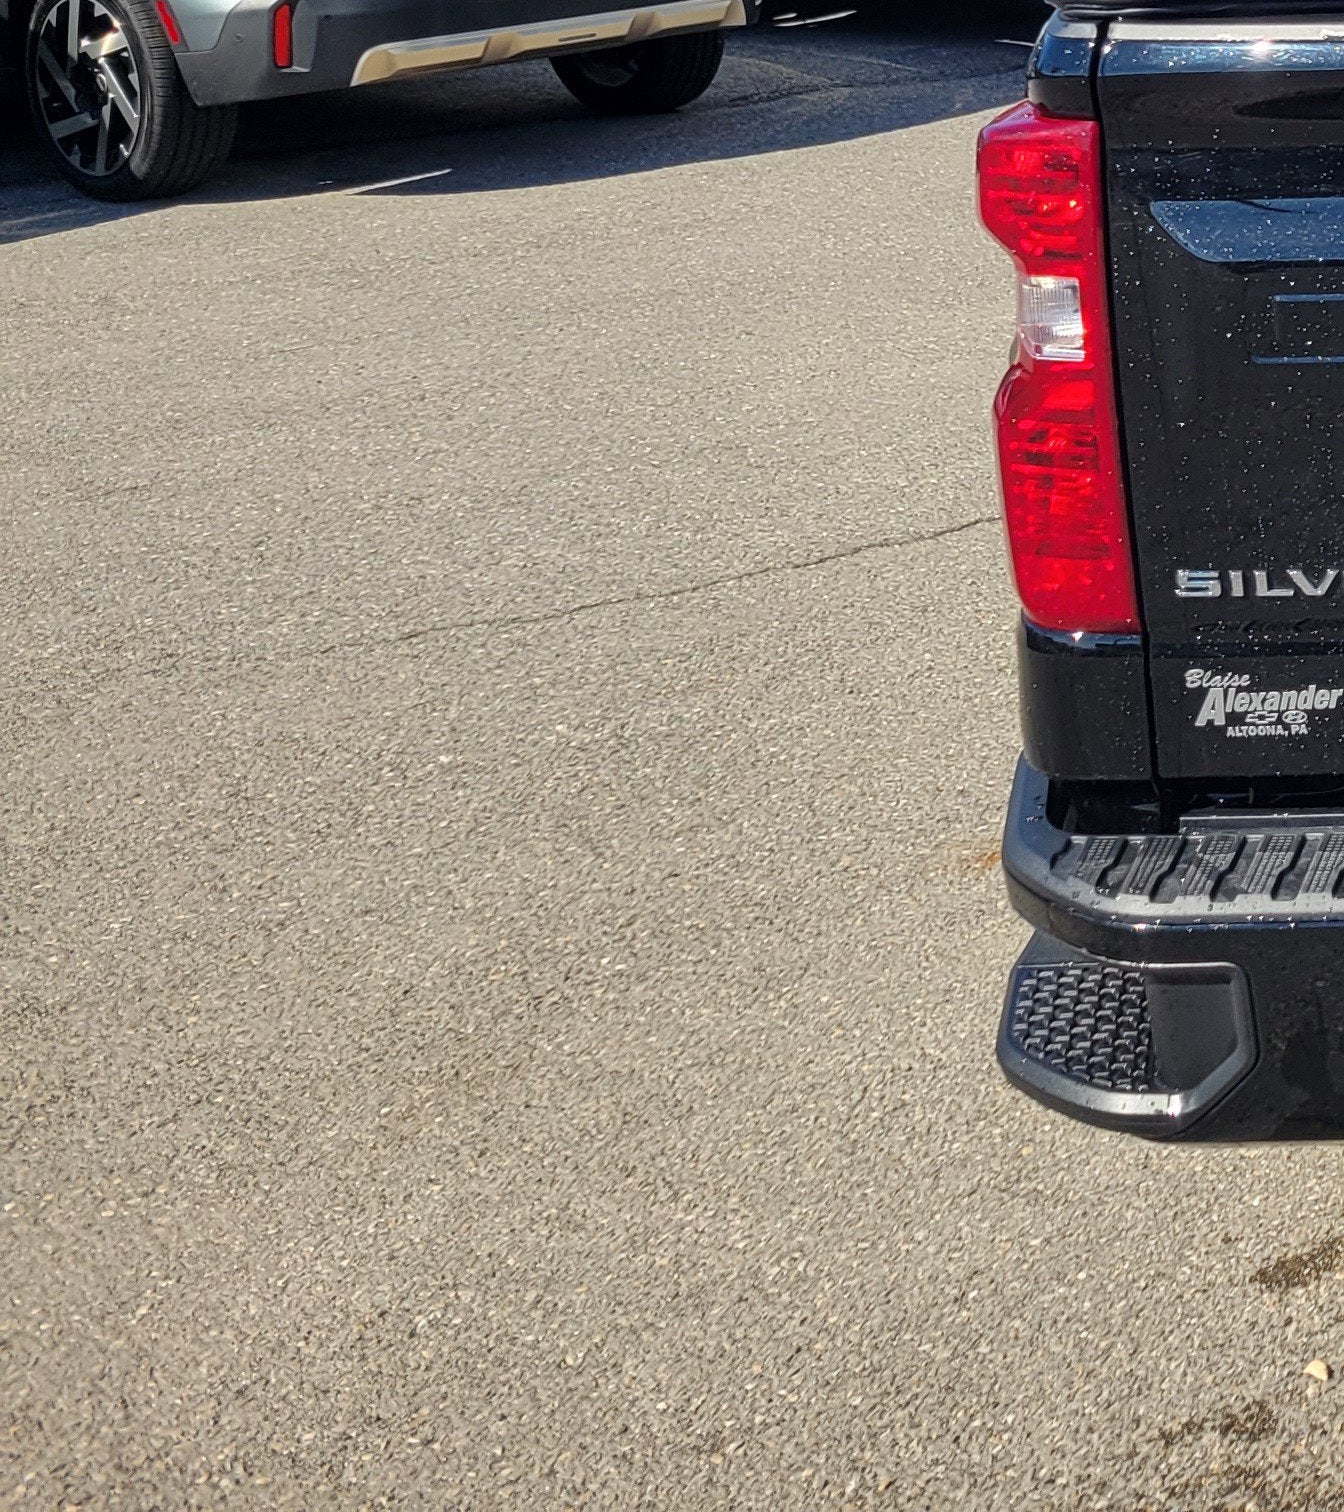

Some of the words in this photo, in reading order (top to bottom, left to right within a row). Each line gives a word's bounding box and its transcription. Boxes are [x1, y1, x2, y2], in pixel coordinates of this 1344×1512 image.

[1184, 668, 1251, 689] Blaise
[1194, 684, 1344, 727] Alexander
[1226, 725, 1289, 738] ALTOONA,
[1291, 724, 1309, 735] PA
